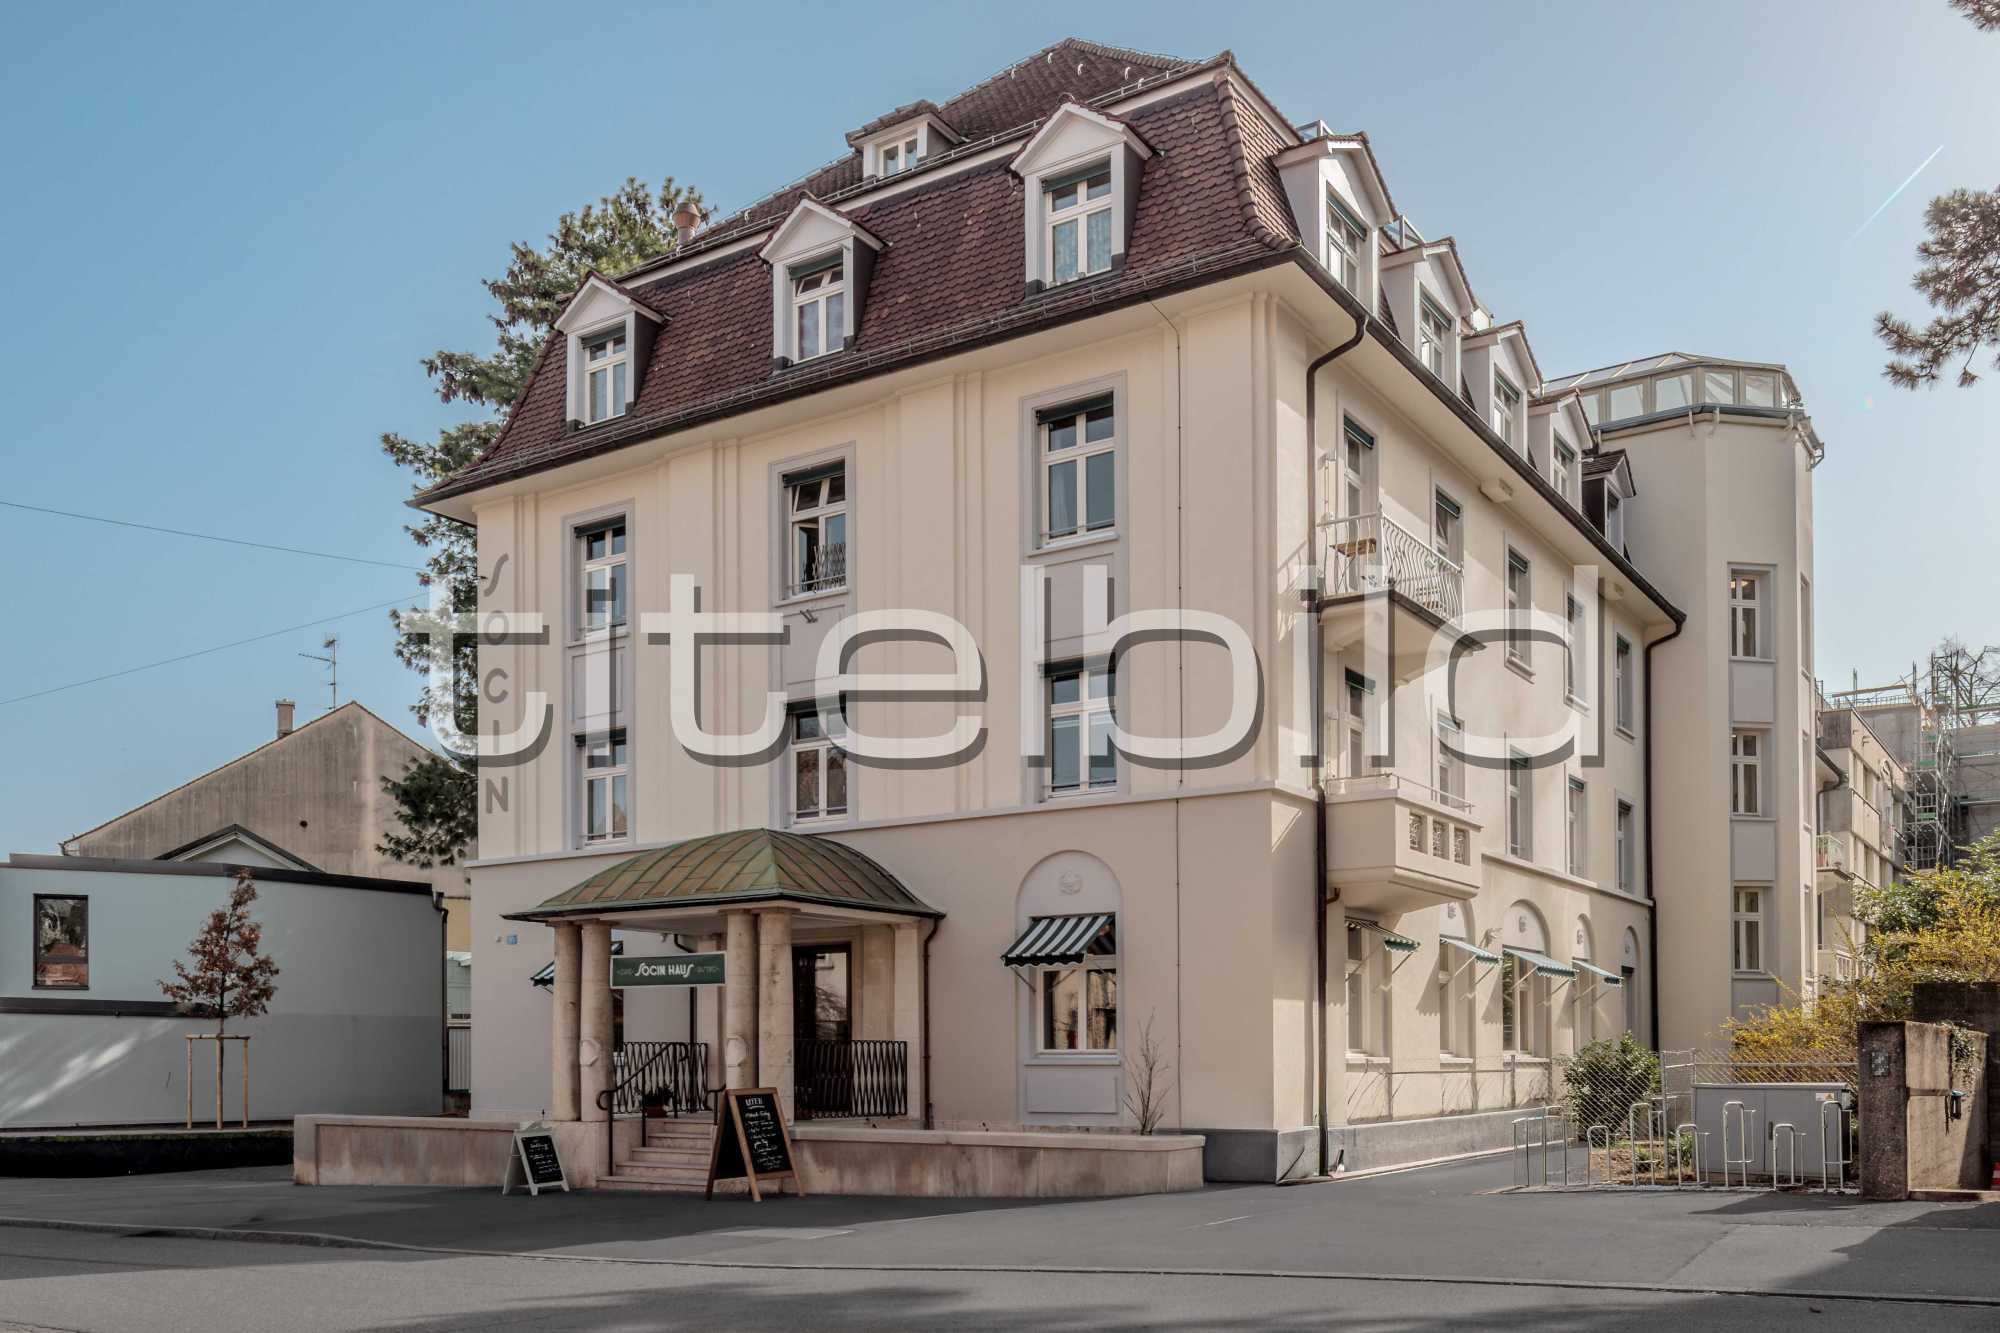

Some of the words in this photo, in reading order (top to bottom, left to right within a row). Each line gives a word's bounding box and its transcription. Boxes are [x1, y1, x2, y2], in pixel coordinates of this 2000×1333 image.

[483, 553, 509, 814] SOCIN
[635, 962, 666, 977] SOCIN
[668, 963, 694, 978] HAUS
